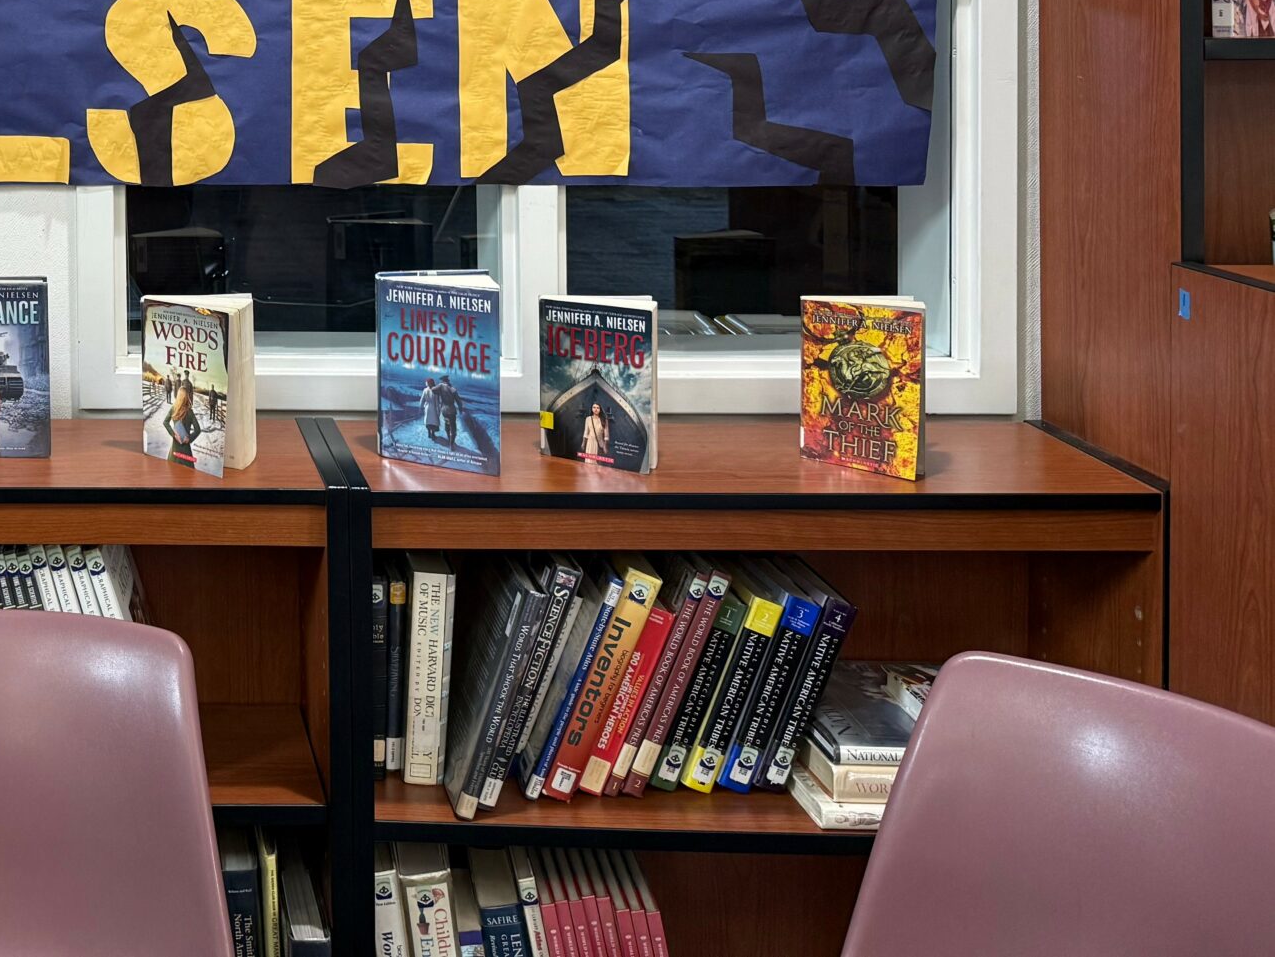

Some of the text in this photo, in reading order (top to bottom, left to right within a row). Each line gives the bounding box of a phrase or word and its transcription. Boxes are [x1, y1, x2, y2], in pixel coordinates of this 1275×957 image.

[386, 288, 433, 307] JENNIFER
[437, 296, 446, 308] A.
[449, 296, 491, 314] NIELSEN
[151, 312, 181, 323] JENNIFER
[193, 318, 218, 330] NIELSEN
[151, 320, 218, 351] WORDS
[400, 307, 477, 338] LINES OF
[546, 309, 592, 326] JENNIFER
[594, 316, 604, 327] A.
[606, 317, 646, 333] NIELSEN
[812, 314, 912, 334] JENNIFER NIELSEN
[165, 345, 208, 373] FIRE
[178, 340, 194, 353] ON
[387, 332, 491, 374] COURAGE
[545, 324, 645, 369] ICEBERG
[821, 395, 903, 432] MARK
[838, 420, 881, 438] OF THE
[823, 429, 897, 462] THIEF
[417, 582, 429, 636] OF MUSIC
[681, 602, 694, 619] THE
[702, 598, 715, 616] THE
[761, 612, 769, 622] 2
[797, 610, 804, 618] 3
[835, 614, 842, 622] 4
[425, 582, 441, 692] THE NEW HARVARD
[520, 585, 570, 691] SCIENCE FICTION
[580, 604, 614, 671] State-by-State Atlas
[668, 619, 687, 650] WORLD
[690, 616, 708, 647] WORLD
[701, 628, 721, 664] NATIVE
[658, 650, 674, 675] BOOK
[679, 646, 696, 671] BOOK
[567, 616, 631, 746] Inventors
[591, 648, 630, 724] biography for beginners
[653, 673, 664, 687] OF
[674, 670, 686, 684] OF
[683, 664, 708, 715] AMERICAN
[706, 631, 758, 749] NATIVE AMERICAN TRIBES
[742, 629, 793, 747] NATIVE AMERICAN TRIBES
[791, 633, 830, 718] NATIVE AMERICAN
[596, 650, 641, 750] 100 AMERICAN HEROES
[615, 673, 645, 734] VALUES IN ACTION
[498, 693, 522, 749] ENCYCLOPEDIA
[504, 707, 526, 757] ILLUSTRATED
[847, 749, 901, 761] NATIONAL
[634, 780, 641, 788] 2
[486, 915, 519, 925] SAFIRE
